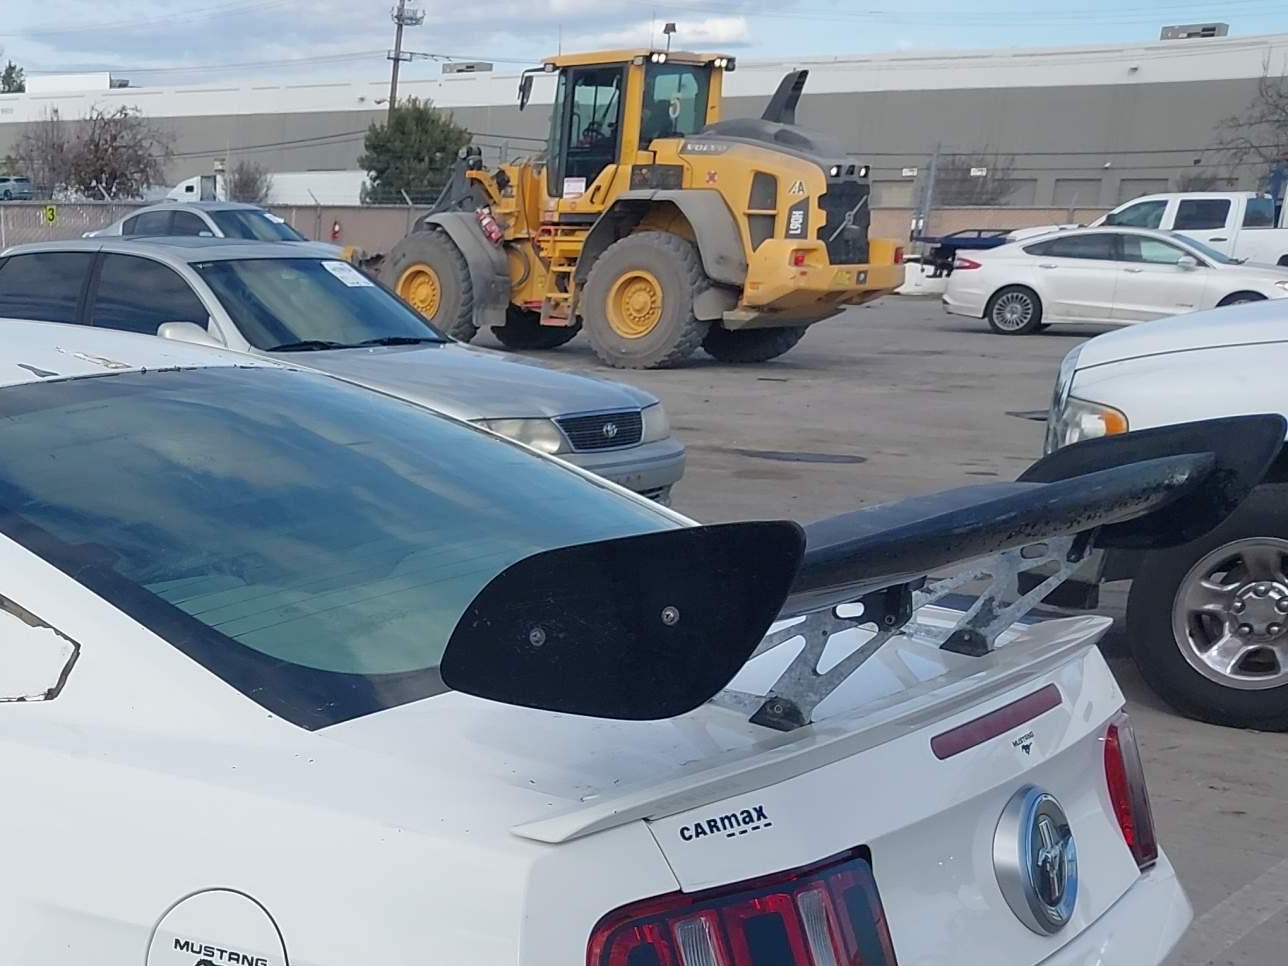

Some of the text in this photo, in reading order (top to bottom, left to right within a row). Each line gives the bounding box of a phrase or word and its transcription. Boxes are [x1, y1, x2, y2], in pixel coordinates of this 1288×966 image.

[47, 207, 55, 222] 3
[788, 210, 805, 234] L90H
[679, 805, 768, 841] CARmax
